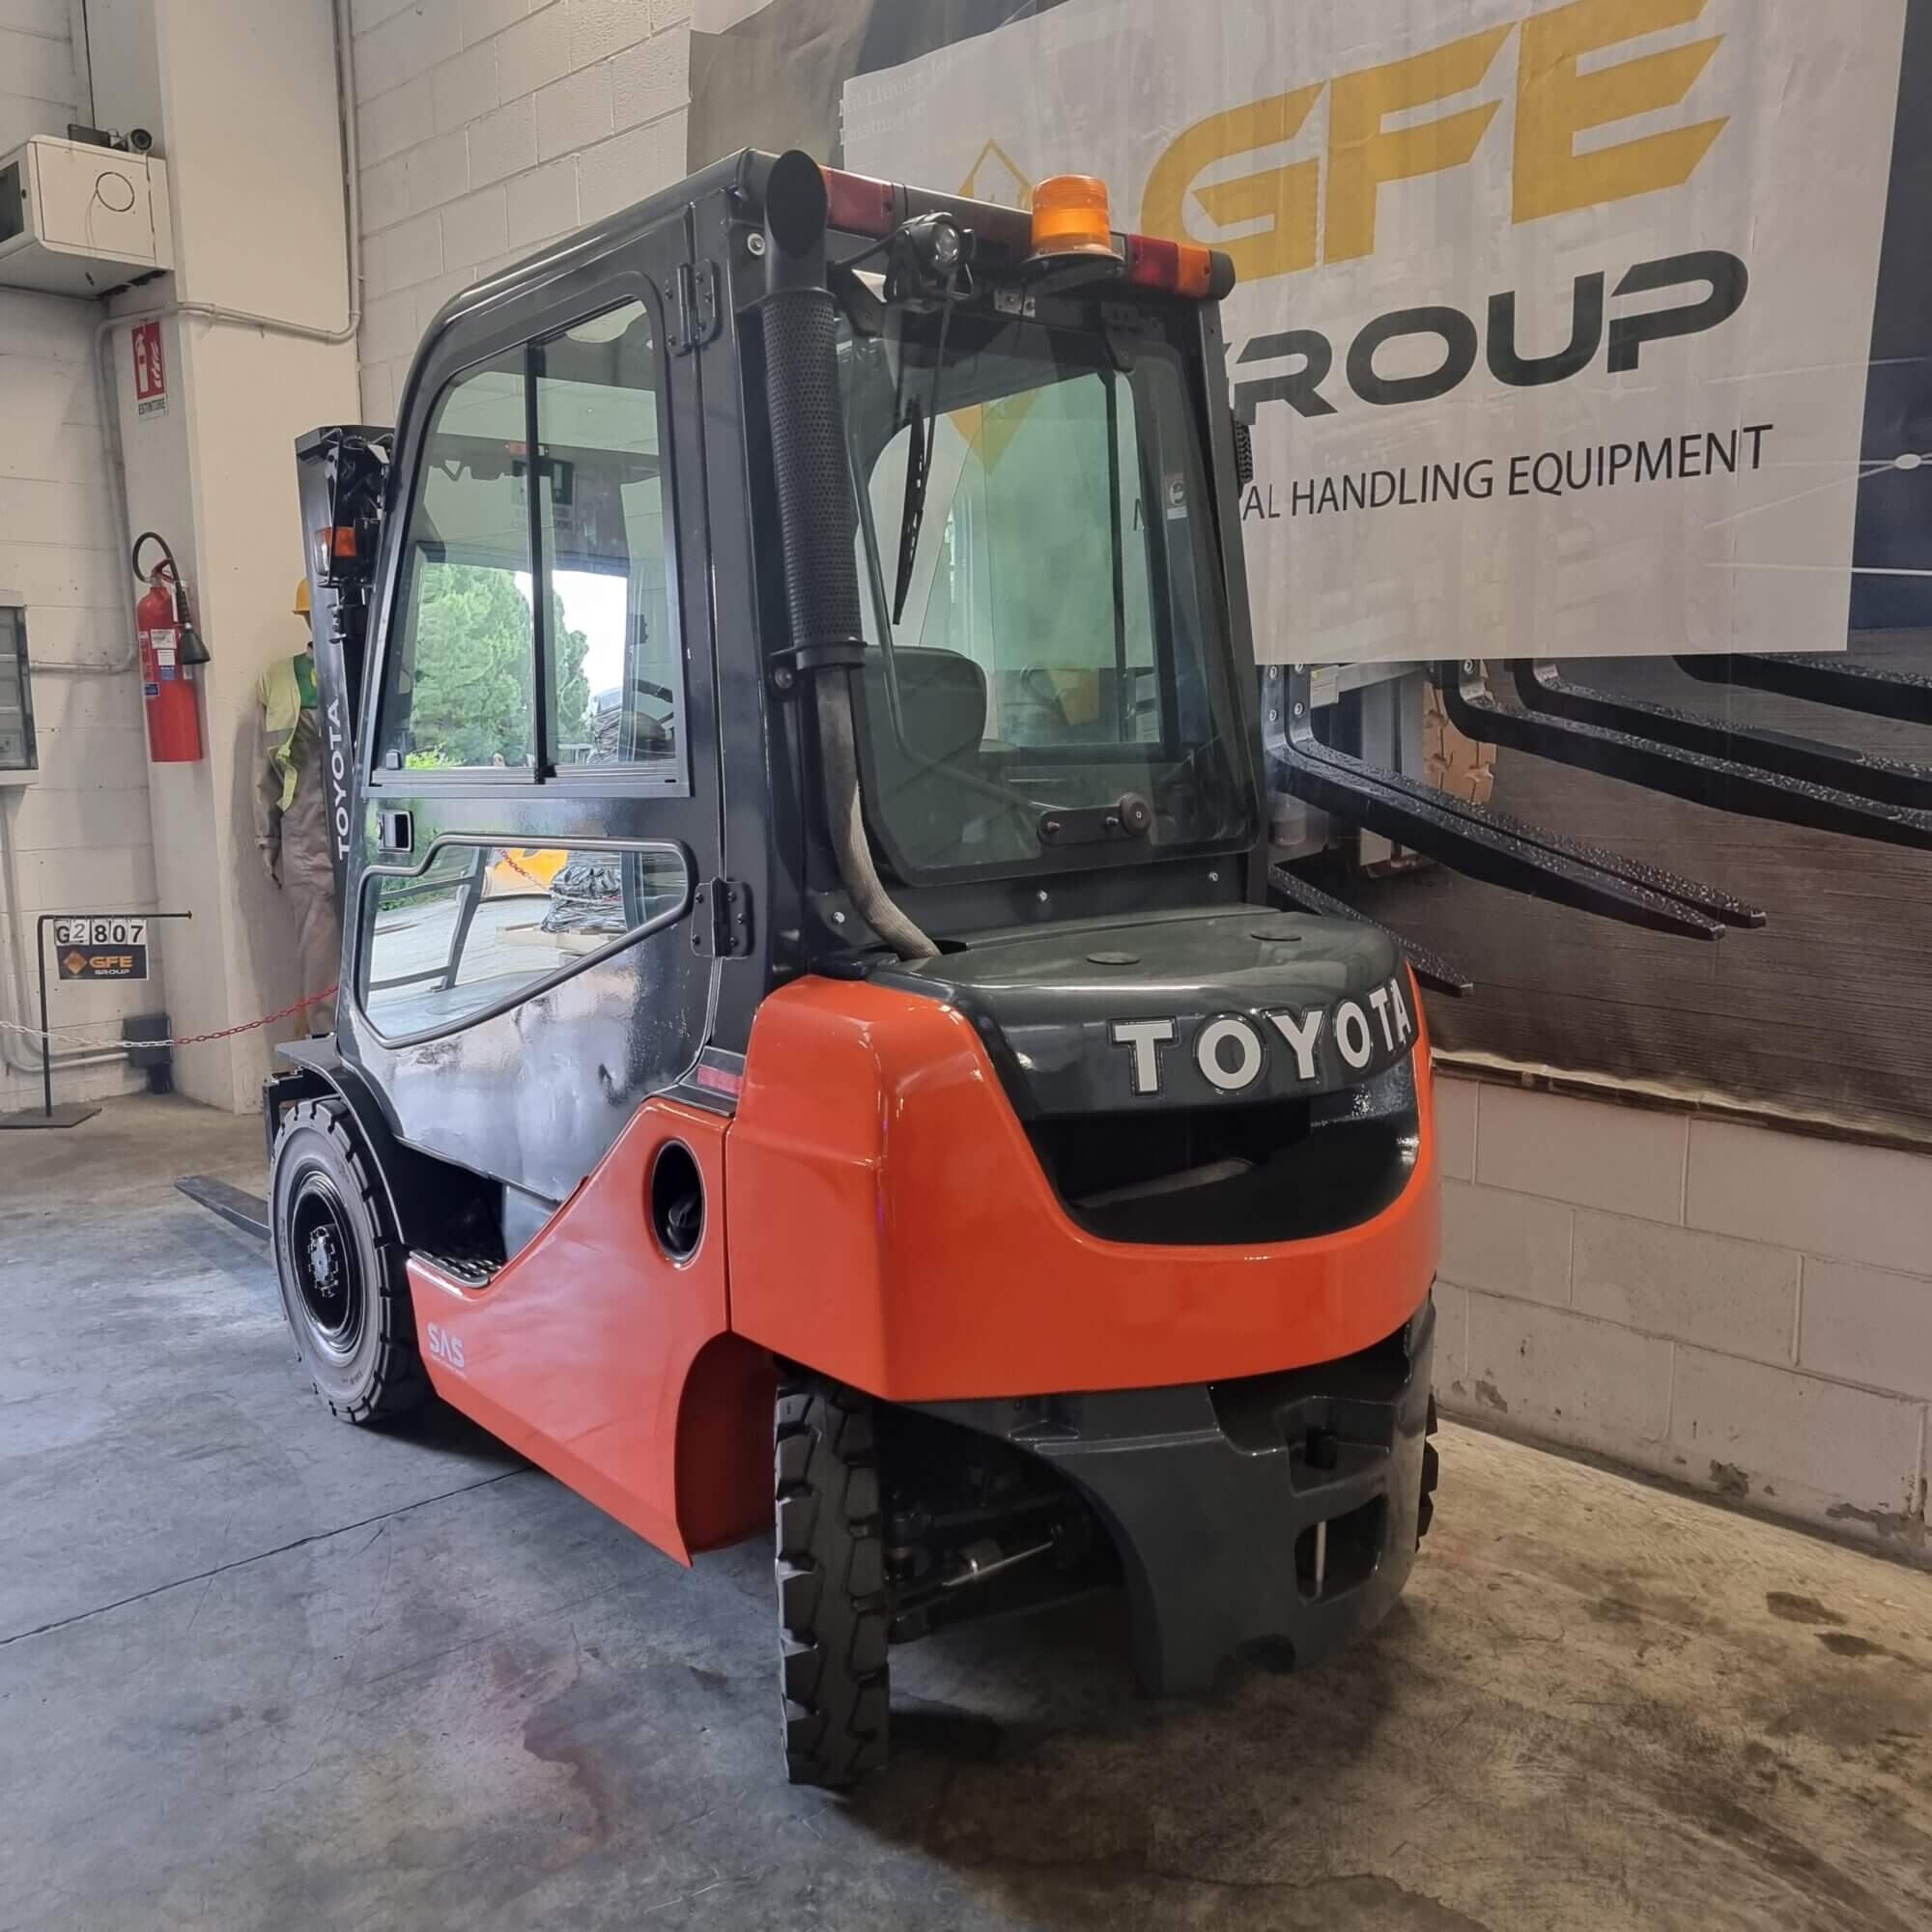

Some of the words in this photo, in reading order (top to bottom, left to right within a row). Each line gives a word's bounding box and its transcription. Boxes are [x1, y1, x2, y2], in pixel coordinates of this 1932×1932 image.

[1140, 0, 1731, 283] GFE
[1223, 249, 1748, 425] ROUP
[1242, 484, 1281, 521] AL
[1292, 459, 1493, 517] HANDLING
[1509, 423, 1774, 497] EQUIPMENT
[327, 697, 351, 861] TOYOTA
[90, 955, 133, 968] GFE
[1113, 978, 1411, 1093] TOYOTA
